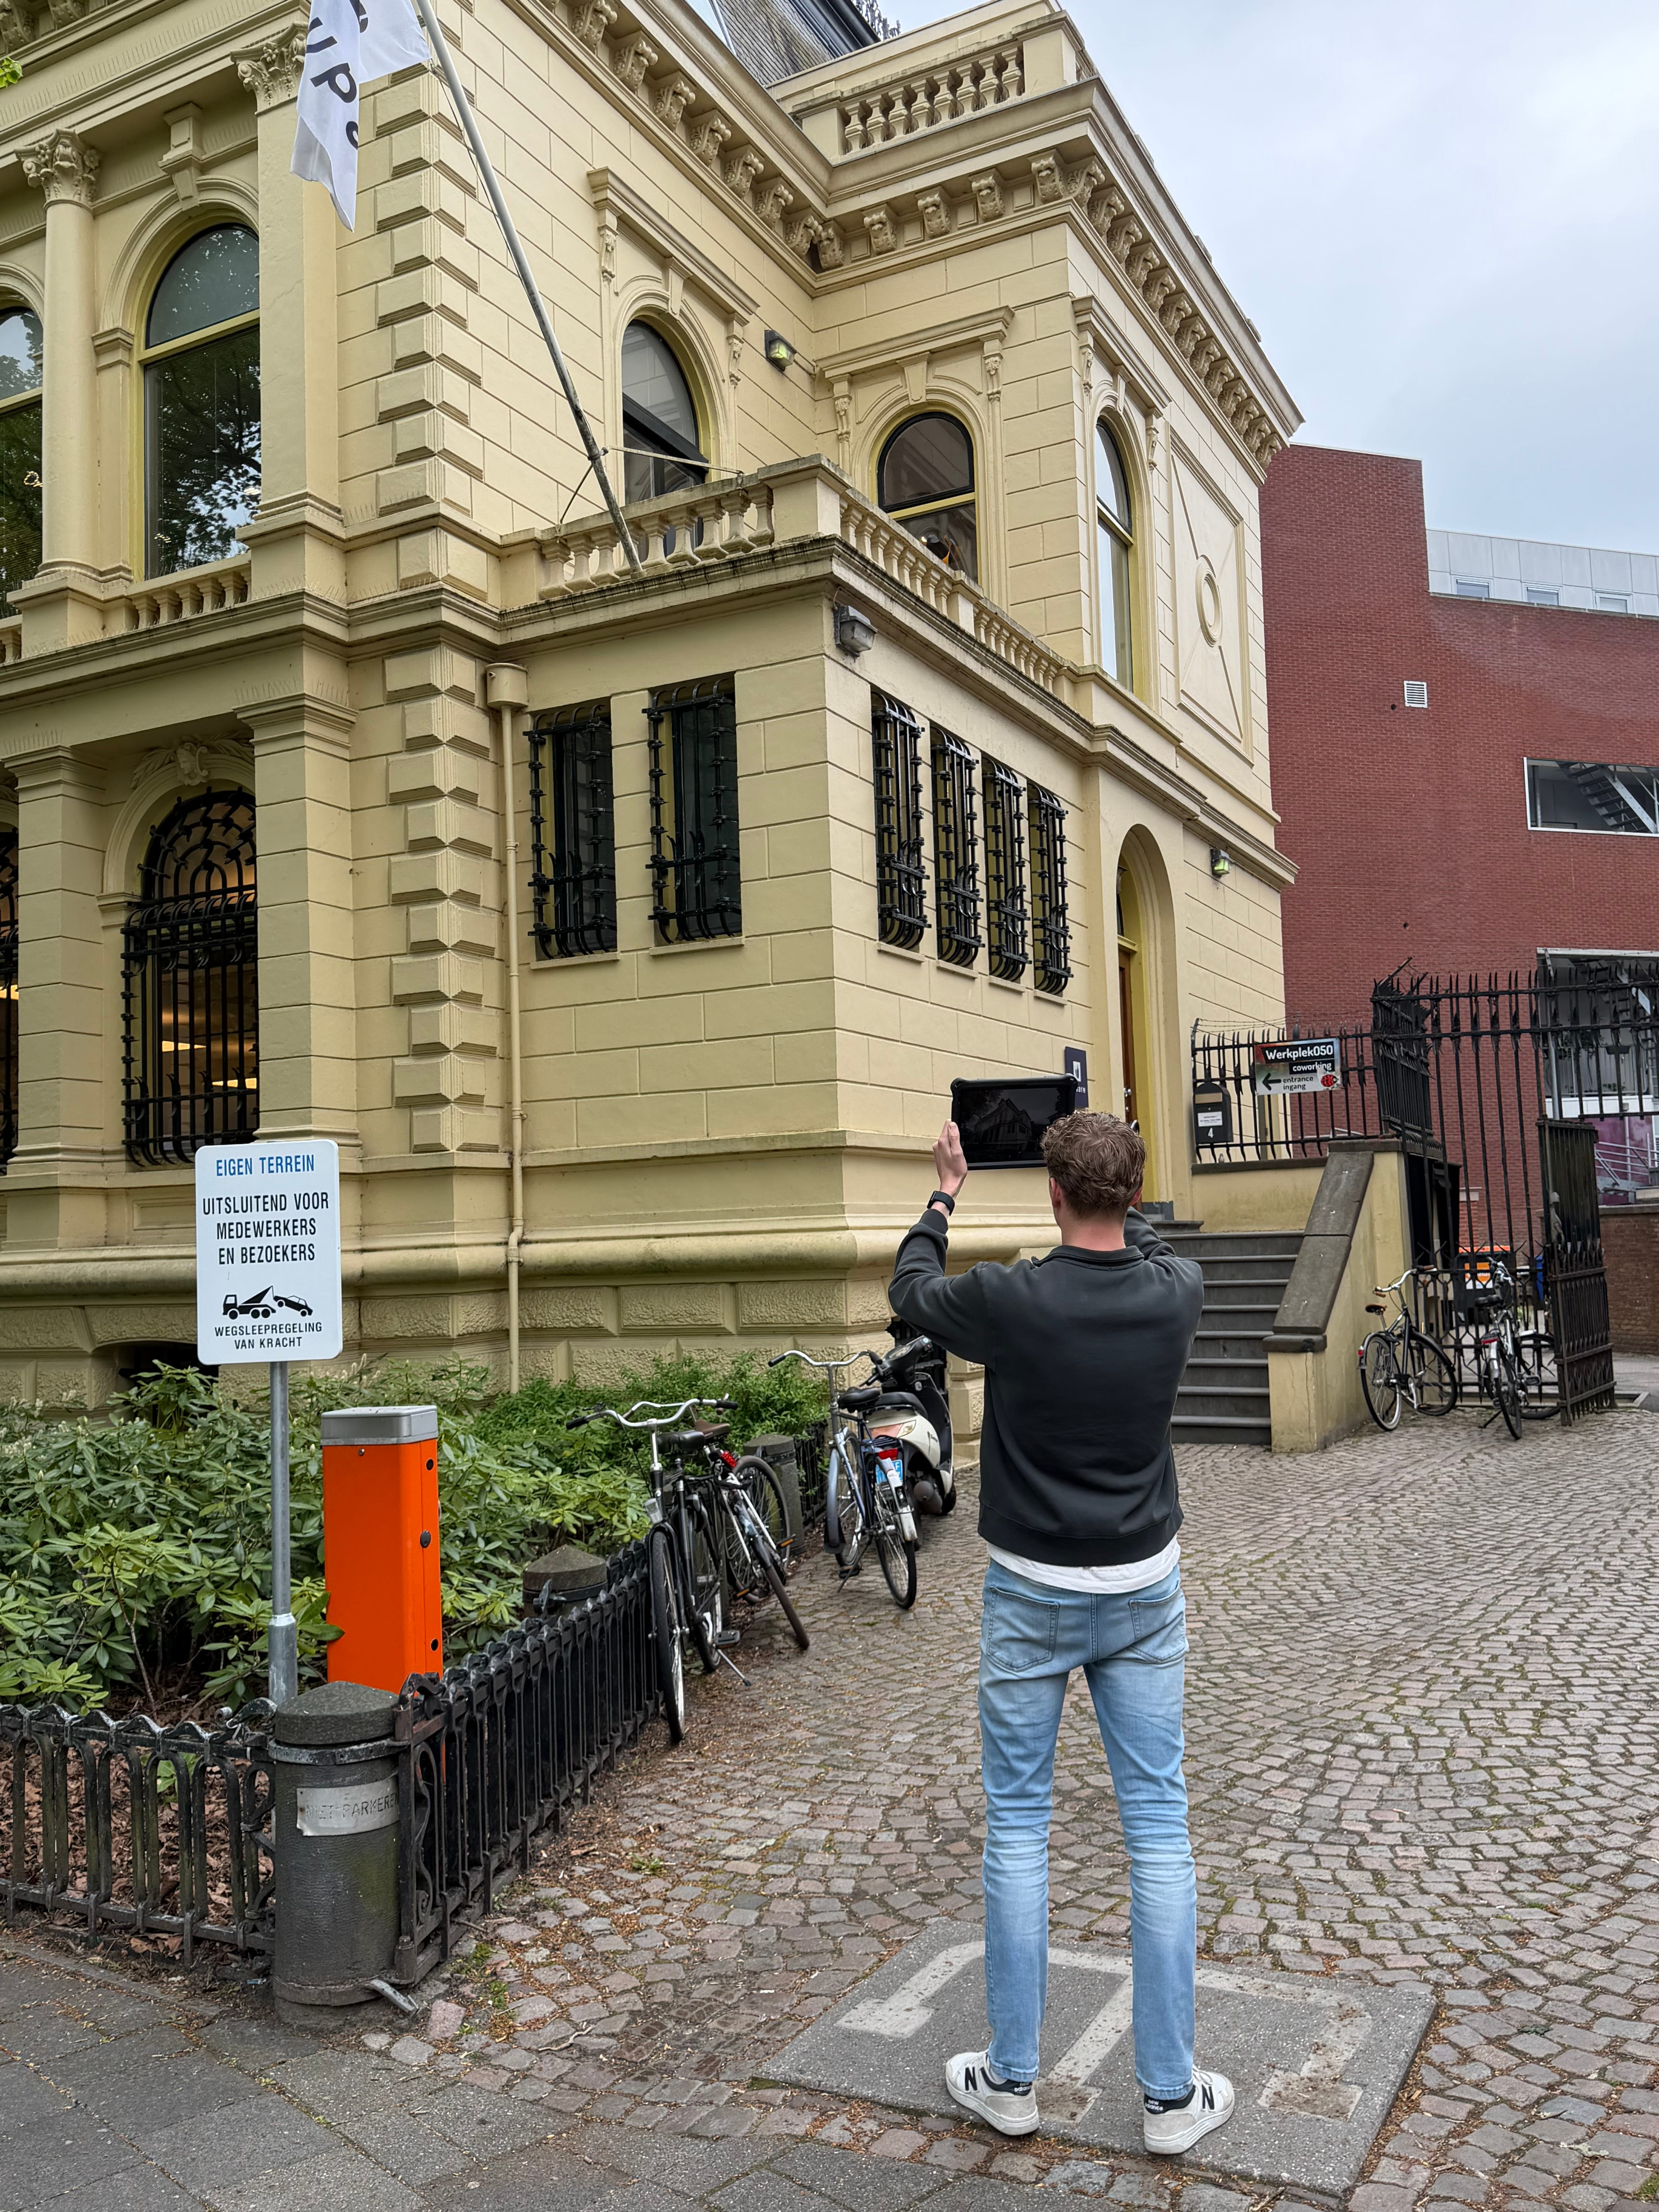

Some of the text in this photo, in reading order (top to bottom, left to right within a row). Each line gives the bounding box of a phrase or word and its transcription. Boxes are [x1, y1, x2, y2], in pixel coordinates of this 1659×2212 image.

[1266, 1045, 1333, 1061] Werkplek050
[1292, 1061, 1332, 1072] coworking
[1208, 1128, 1214, 1138] 4
[216, 1154, 314, 1176] EIGEN TERREIN
[203, 1192, 329, 1215] UITSLUITEND VOOR
[216, 1218, 316, 1239] MEDEWERKERS
[218, 1243, 315, 1264] EN BEZOEKERS
[215, 1322, 322, 1336] WEGSLEEPREGELING
[235, 1336, 302, 1350] VAN KRACHT
[965, 2067, 977, 2091] N
[1202, 2084, 1215, 2109] N
